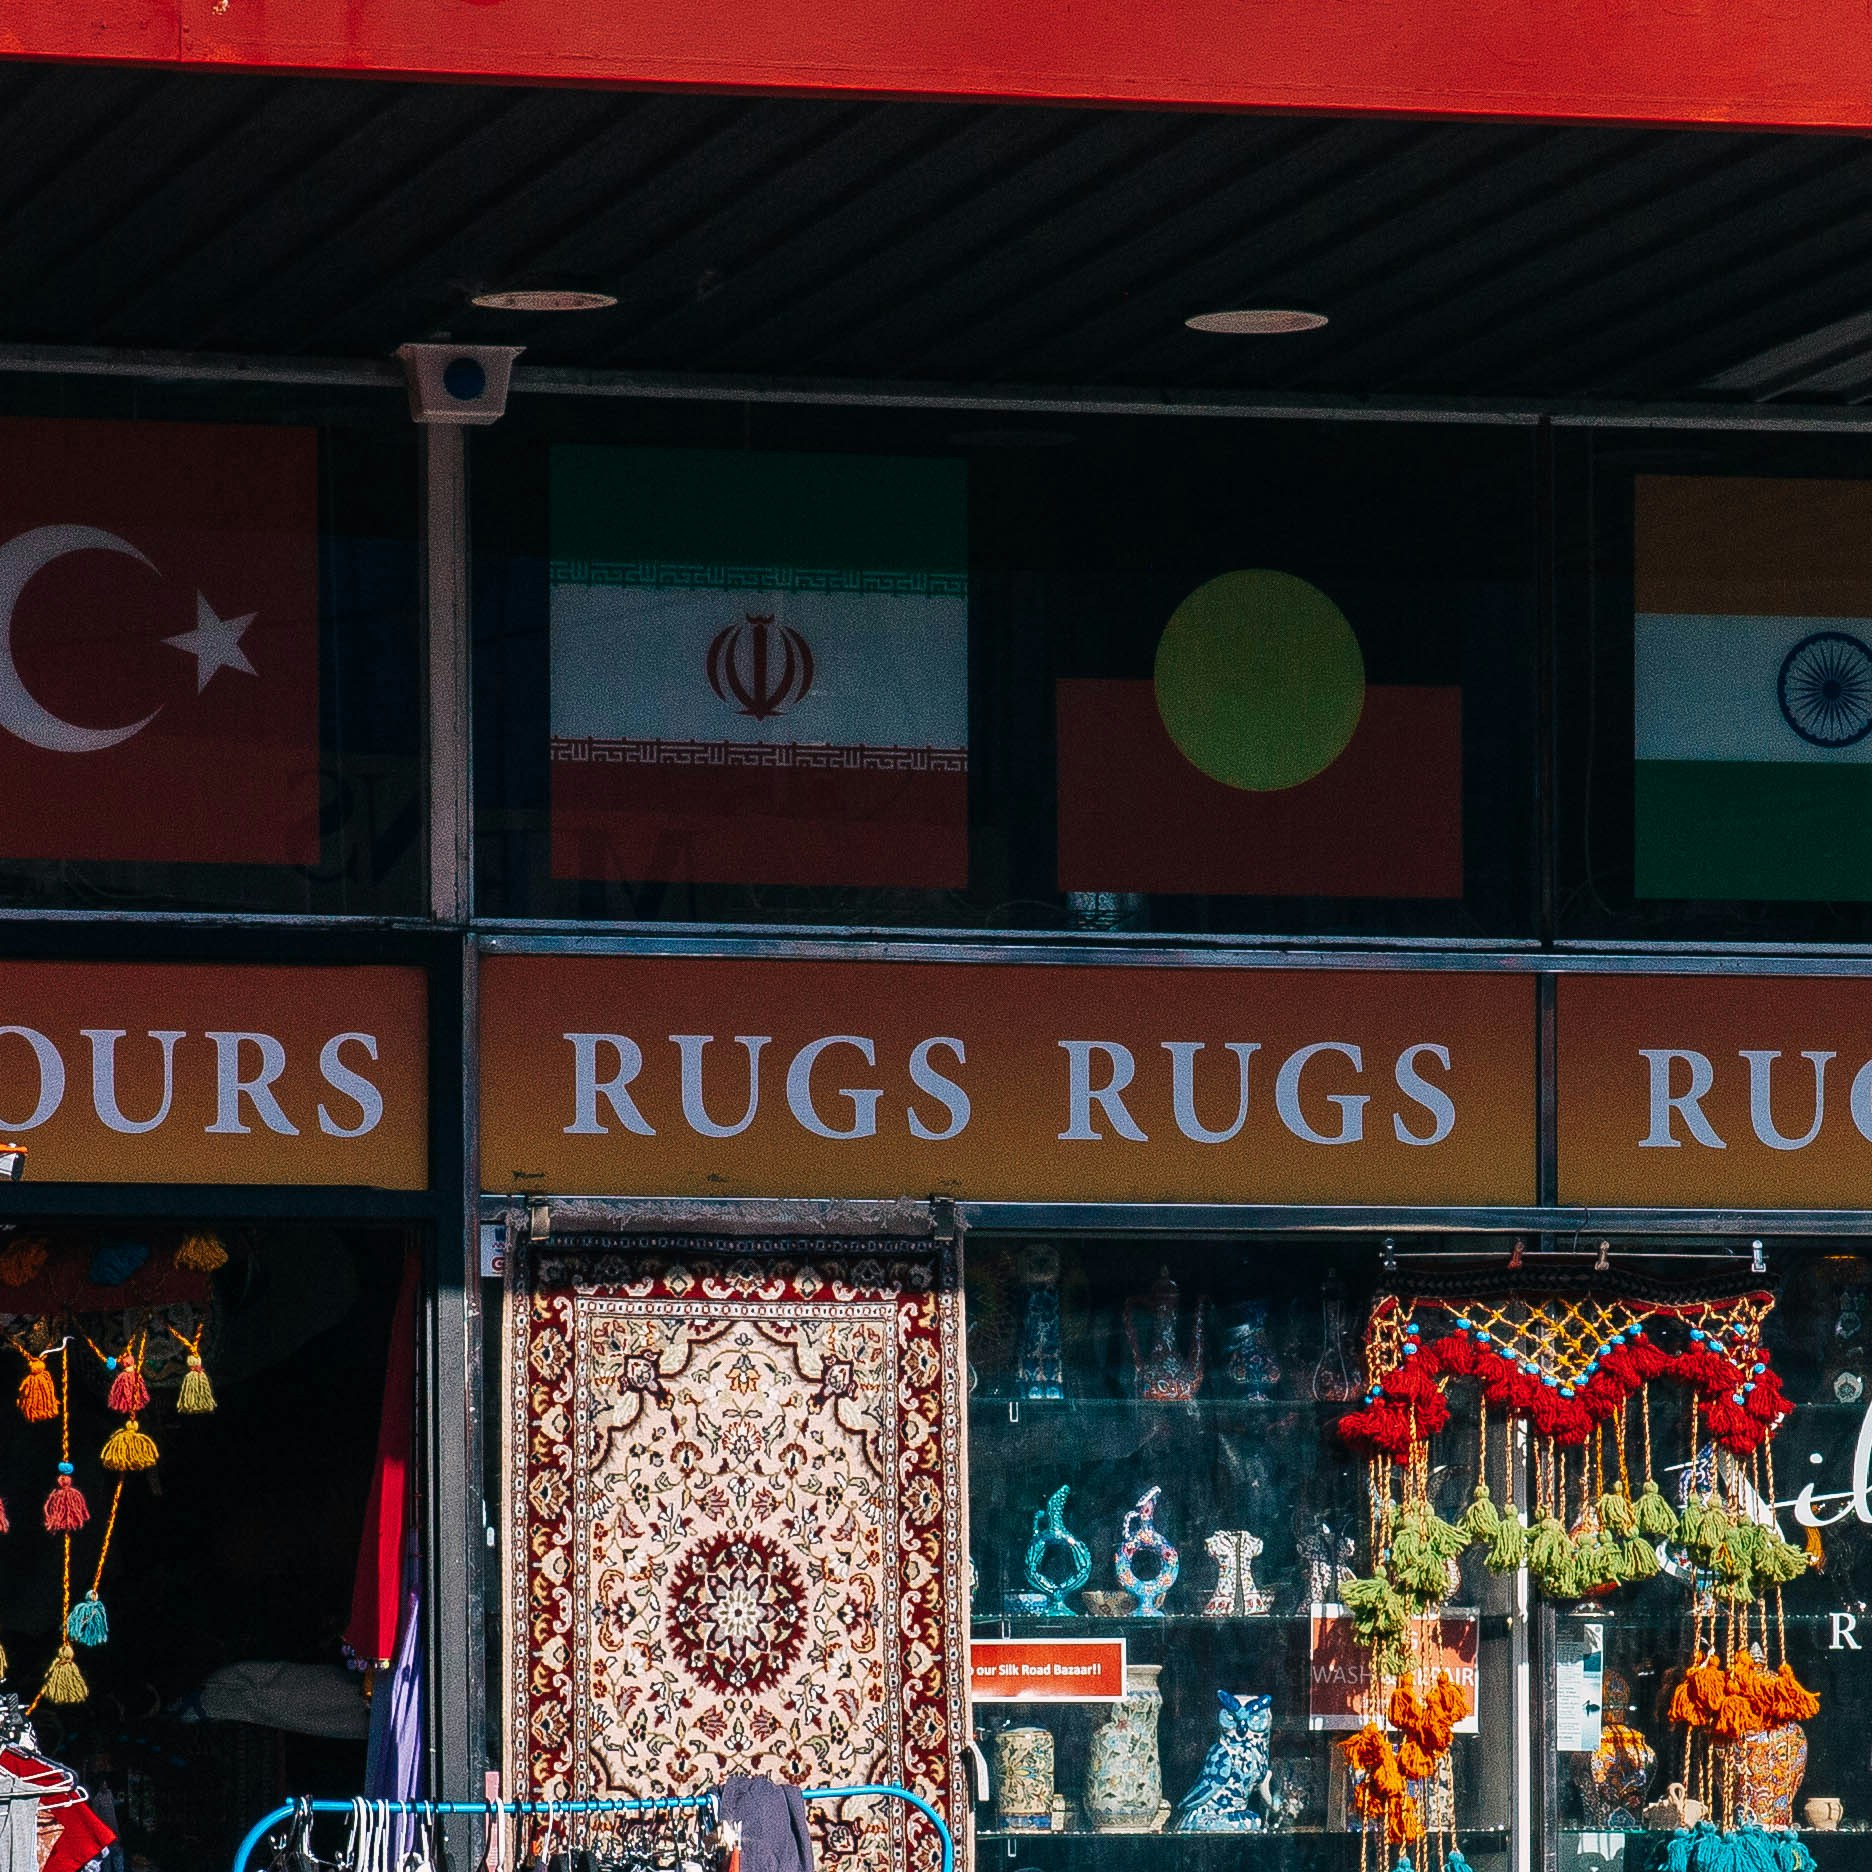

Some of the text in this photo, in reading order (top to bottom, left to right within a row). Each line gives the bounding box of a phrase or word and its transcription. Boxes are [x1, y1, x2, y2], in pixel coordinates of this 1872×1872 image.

[562, 1031, 1458, 1147] RUGS RUGS
[976, 1667, 997, 1676] our
[999, 1663, 1019, 1676] Silk
[1022, 1663, 1051, 1676] Road
[1053, 1663, 1102, 1676] Bazaar!!
